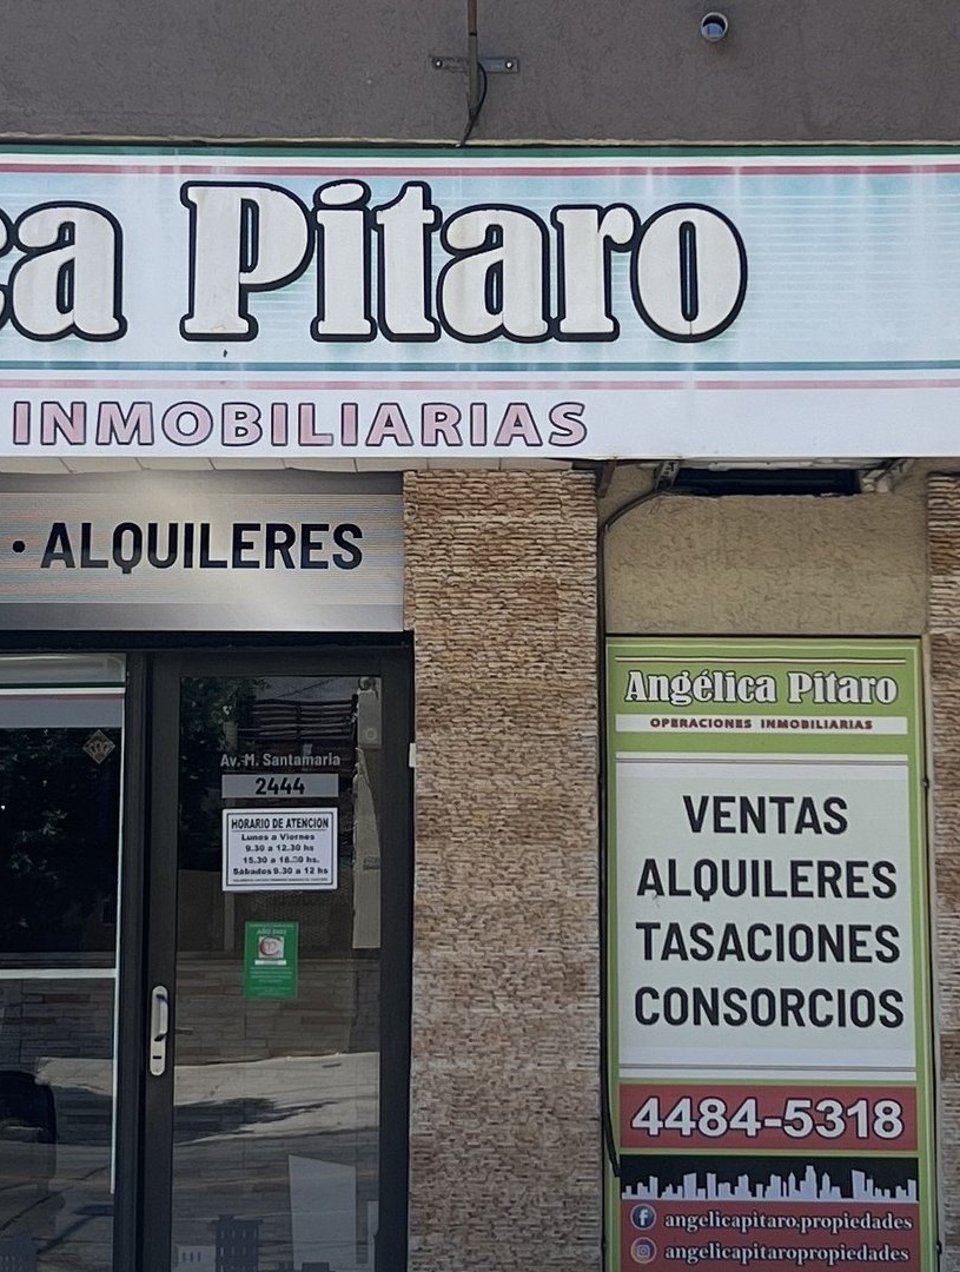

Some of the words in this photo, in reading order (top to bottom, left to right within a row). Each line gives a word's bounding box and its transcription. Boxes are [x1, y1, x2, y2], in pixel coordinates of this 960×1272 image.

[180, 179, 748, 344] Pitaro
[13, 401, 589, 448] INMOBILIARIAS
[40, 521, 364, 574] ALQUILERES
[625, 670, 777, 706] Angélica
[786, 671, 898, 704] Pitaro
[649, 717, 753, 730] OPERACIONES
[760, 718, 874, 731] INMOBILIARIAS
[220, 754, 241, 767] Av.
[244, 753, 259, 767] M.
[255, 777, 305, 795] 2444
[231, 818, 270, 829] HORARIO
[272, 818, 284, 829] DE
[683, 795, 848, 835] VENTAS
[241, 833, 269, 841] Lunes
[280, 833, 315, 841] Viernes
[245, 844, 265, 852] 9.30
[637, 858, 897, 902] ALQUILERES
[635, 922, 901, 964] TASACIONES
[635, 986, 904, 1028] CONSORCIOS
[630, 1096, 905, 1139] 4484-5318
[664, 1210, 913, 1234] angelicapitaro.propiedades
[664, 1242, 910, 1266] angelicapitaropropiedades
